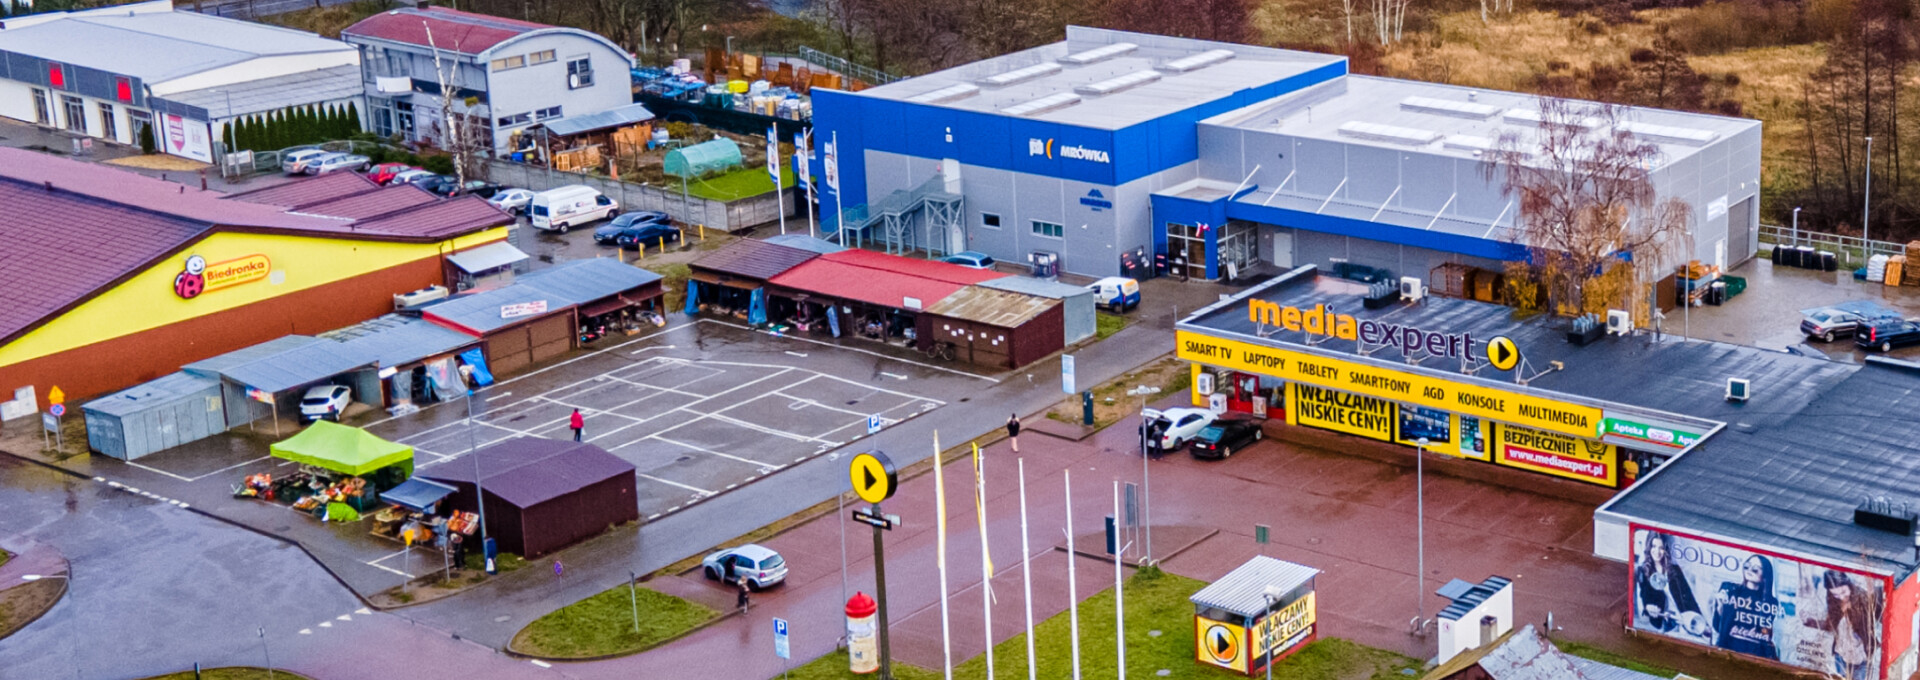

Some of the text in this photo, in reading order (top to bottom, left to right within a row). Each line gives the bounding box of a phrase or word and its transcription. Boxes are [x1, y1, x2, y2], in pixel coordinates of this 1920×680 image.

[1060, 145, 1109, 163] MRÓWKA
[207, 262, 265, 280] Biedronka
[1186, 341, 1588, 428] SMART TV LAPTOPY TABLETY SMARTFONY AGD KONSOLE MULTIMEDIA
[871, 415, 878, 427] P
[1300, 401, 1388, 434] NISKIE CENY!
[1614, 423, 1643, 436] Apteka
[1504, 430, 1577, 456] BEZPIECZNIE!
[1509, 449, 1603, 476] www.mediaexpert.pl
[1671, 544, 1740, 572] SOLDO
[777, 620, 785, 633] P
[1734, 611, 1772, 629] JESTEŚ
